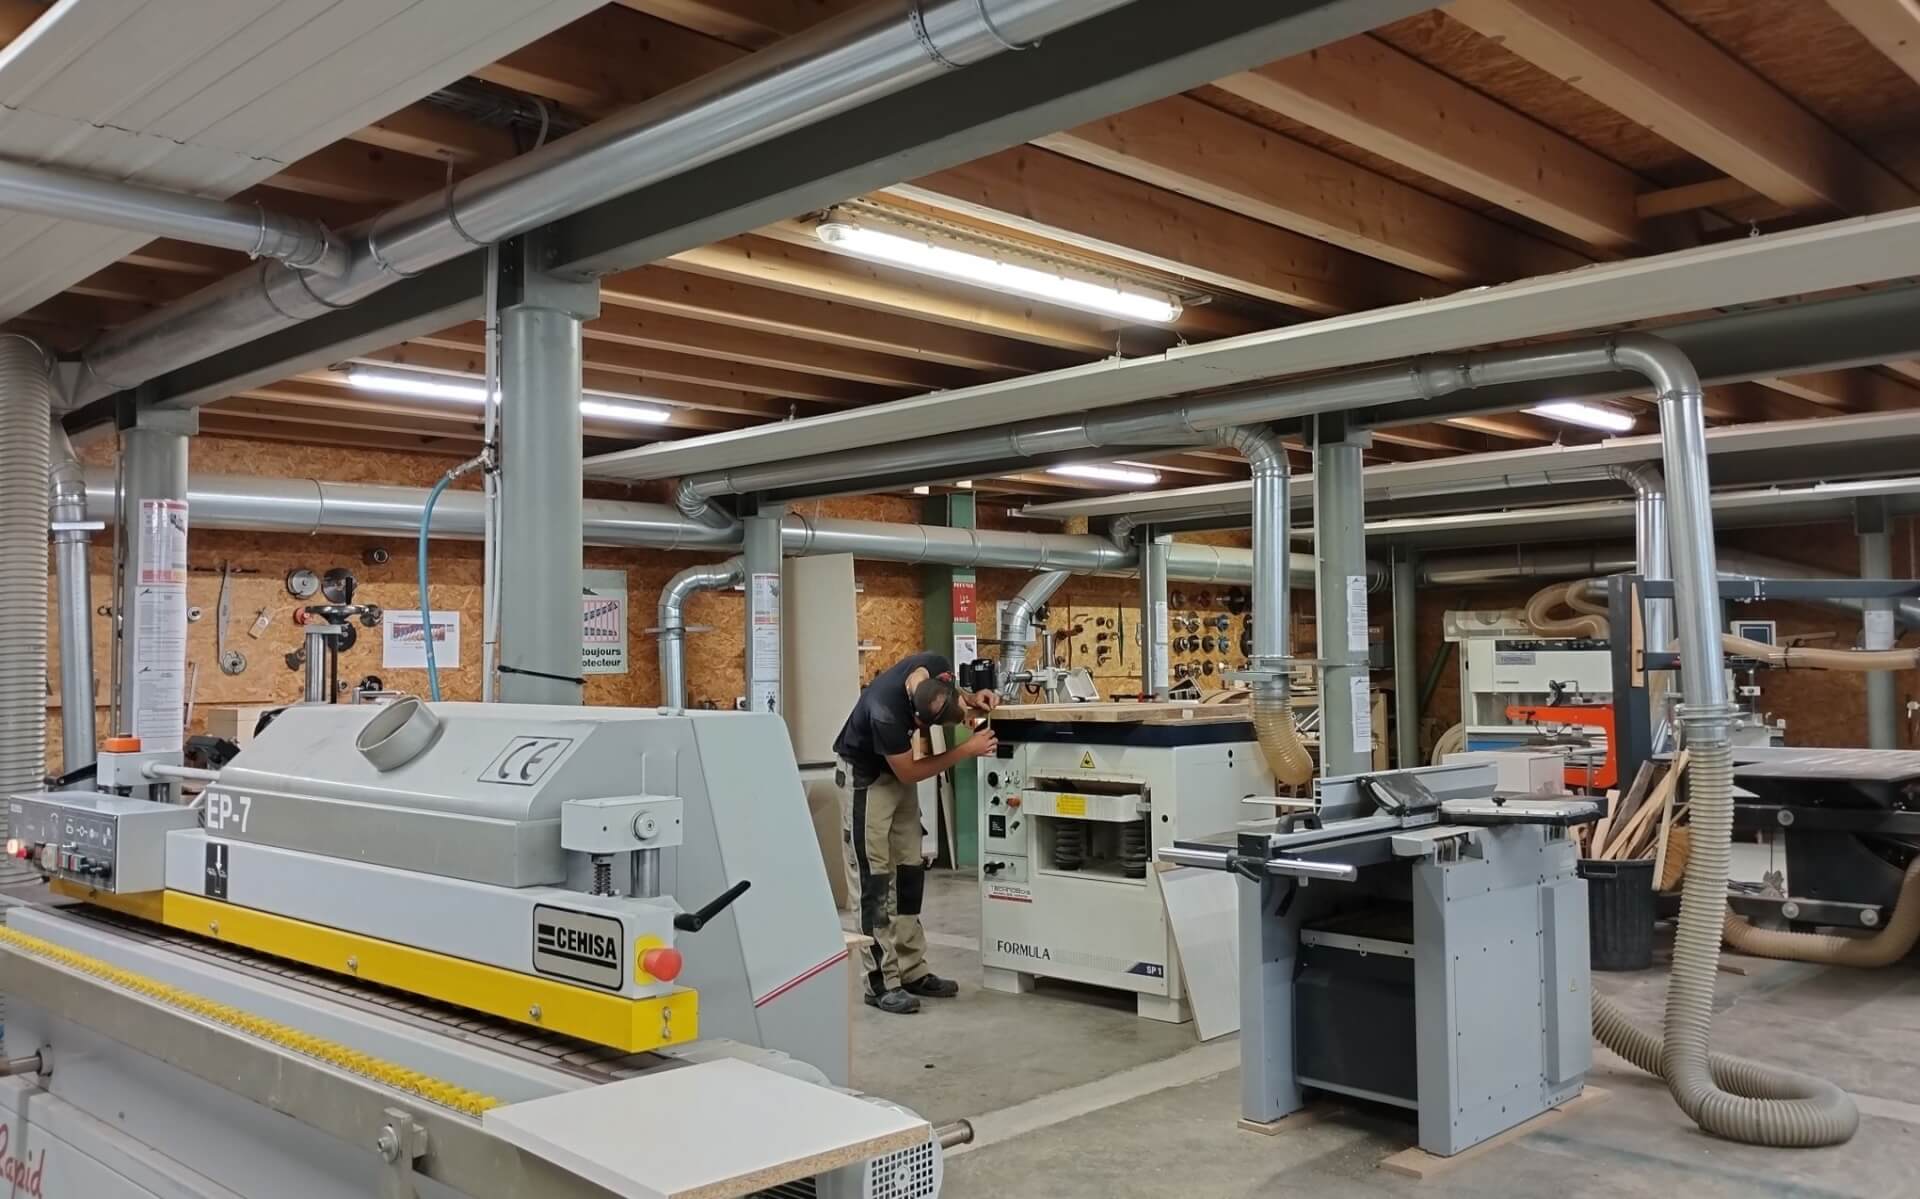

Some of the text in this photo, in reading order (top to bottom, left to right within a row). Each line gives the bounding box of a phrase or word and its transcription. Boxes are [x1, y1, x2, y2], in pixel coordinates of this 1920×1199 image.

[582, 647, 621, 658] toujours
[582, 658, 621, 667] otecteur
[207, 792, 251, 833] EP-7
[556, 926, 617, 960] CEHISA
[997, 940, 1051, 961] FORMULA
